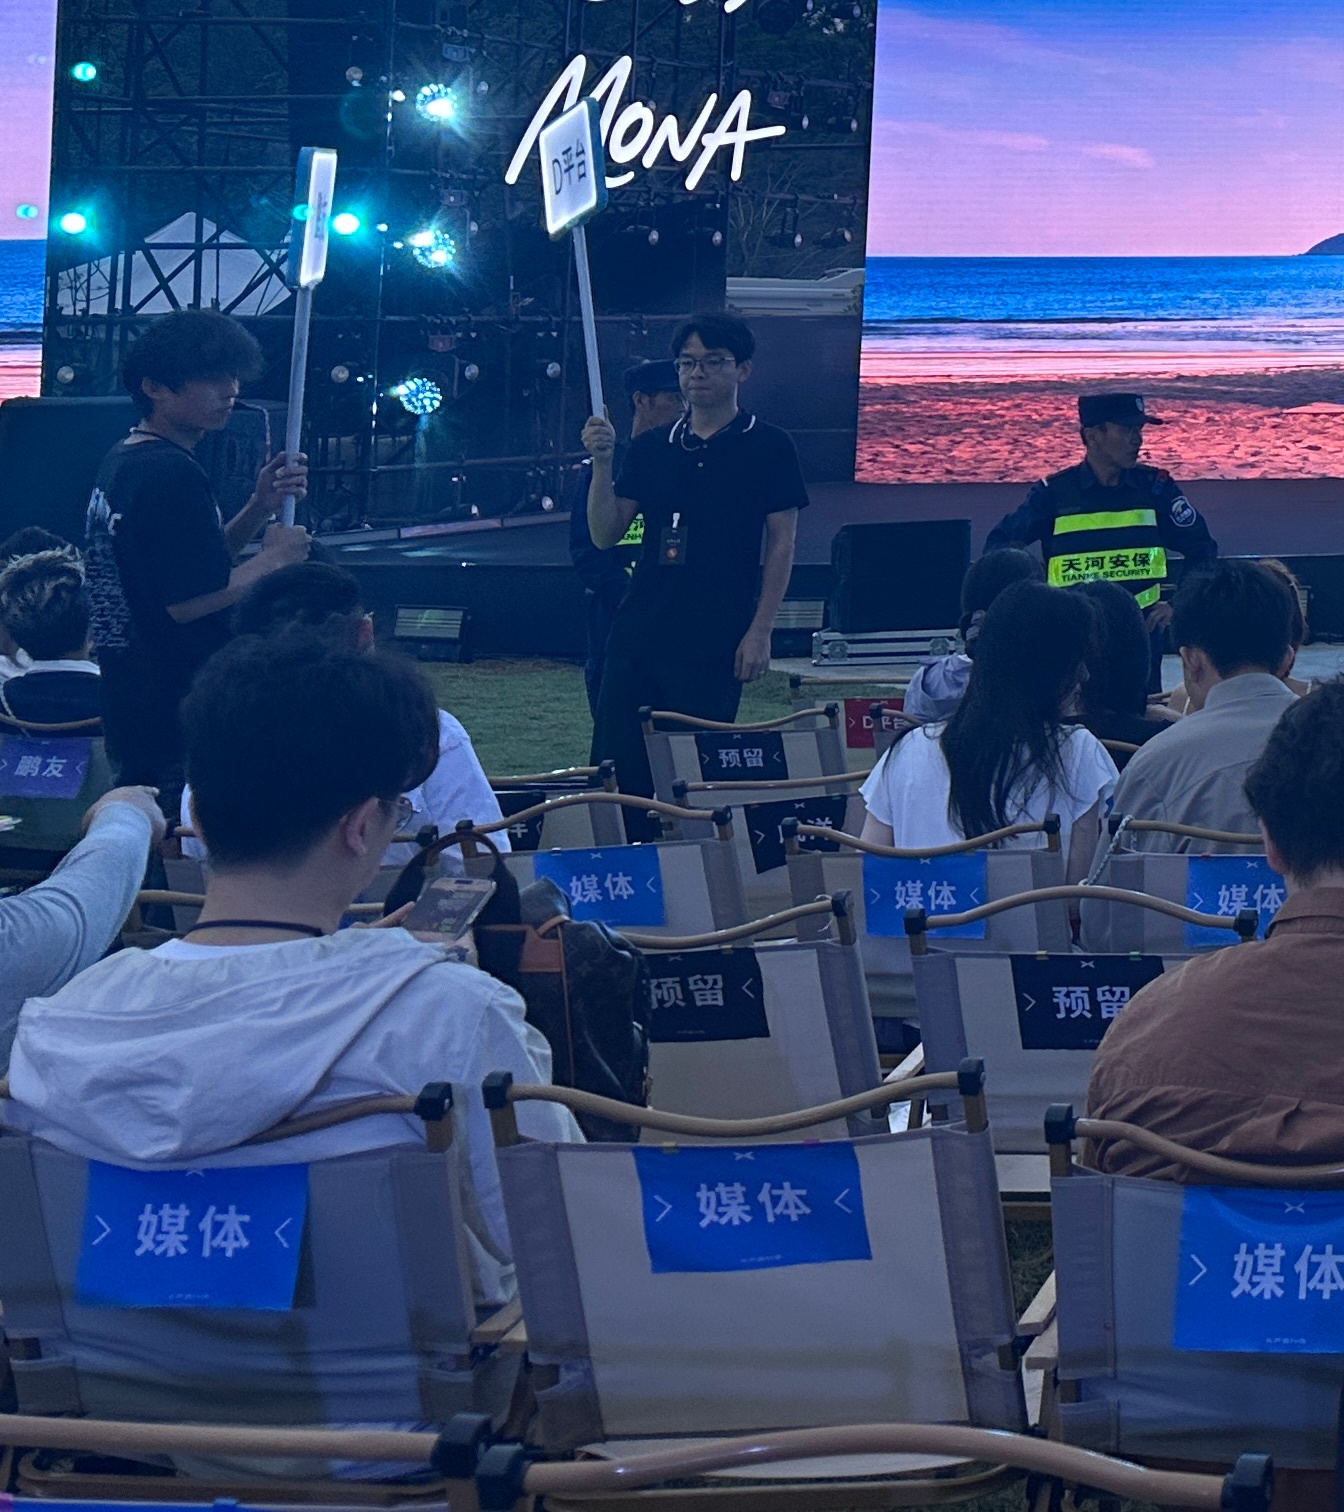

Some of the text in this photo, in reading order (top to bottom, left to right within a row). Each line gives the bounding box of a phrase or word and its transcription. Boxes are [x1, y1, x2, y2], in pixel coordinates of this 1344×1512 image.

[551, 138, 587, 196] D平台
[1062, 552, 1150, 573] 天河安保
[14, 755, 67, 777] 鹏友
[717, 746, 765, 769] 预留
[570, 872, 634, 907] 媒体
[895, 879, 957, 912] 媒体
[1217, 884, 1286, 916] 媒体
[1052, 986, 1130, 1019] 预留
[697, 1181, 811, 1229] 媒体
[136, 1204, 251, 1258] 媒体
